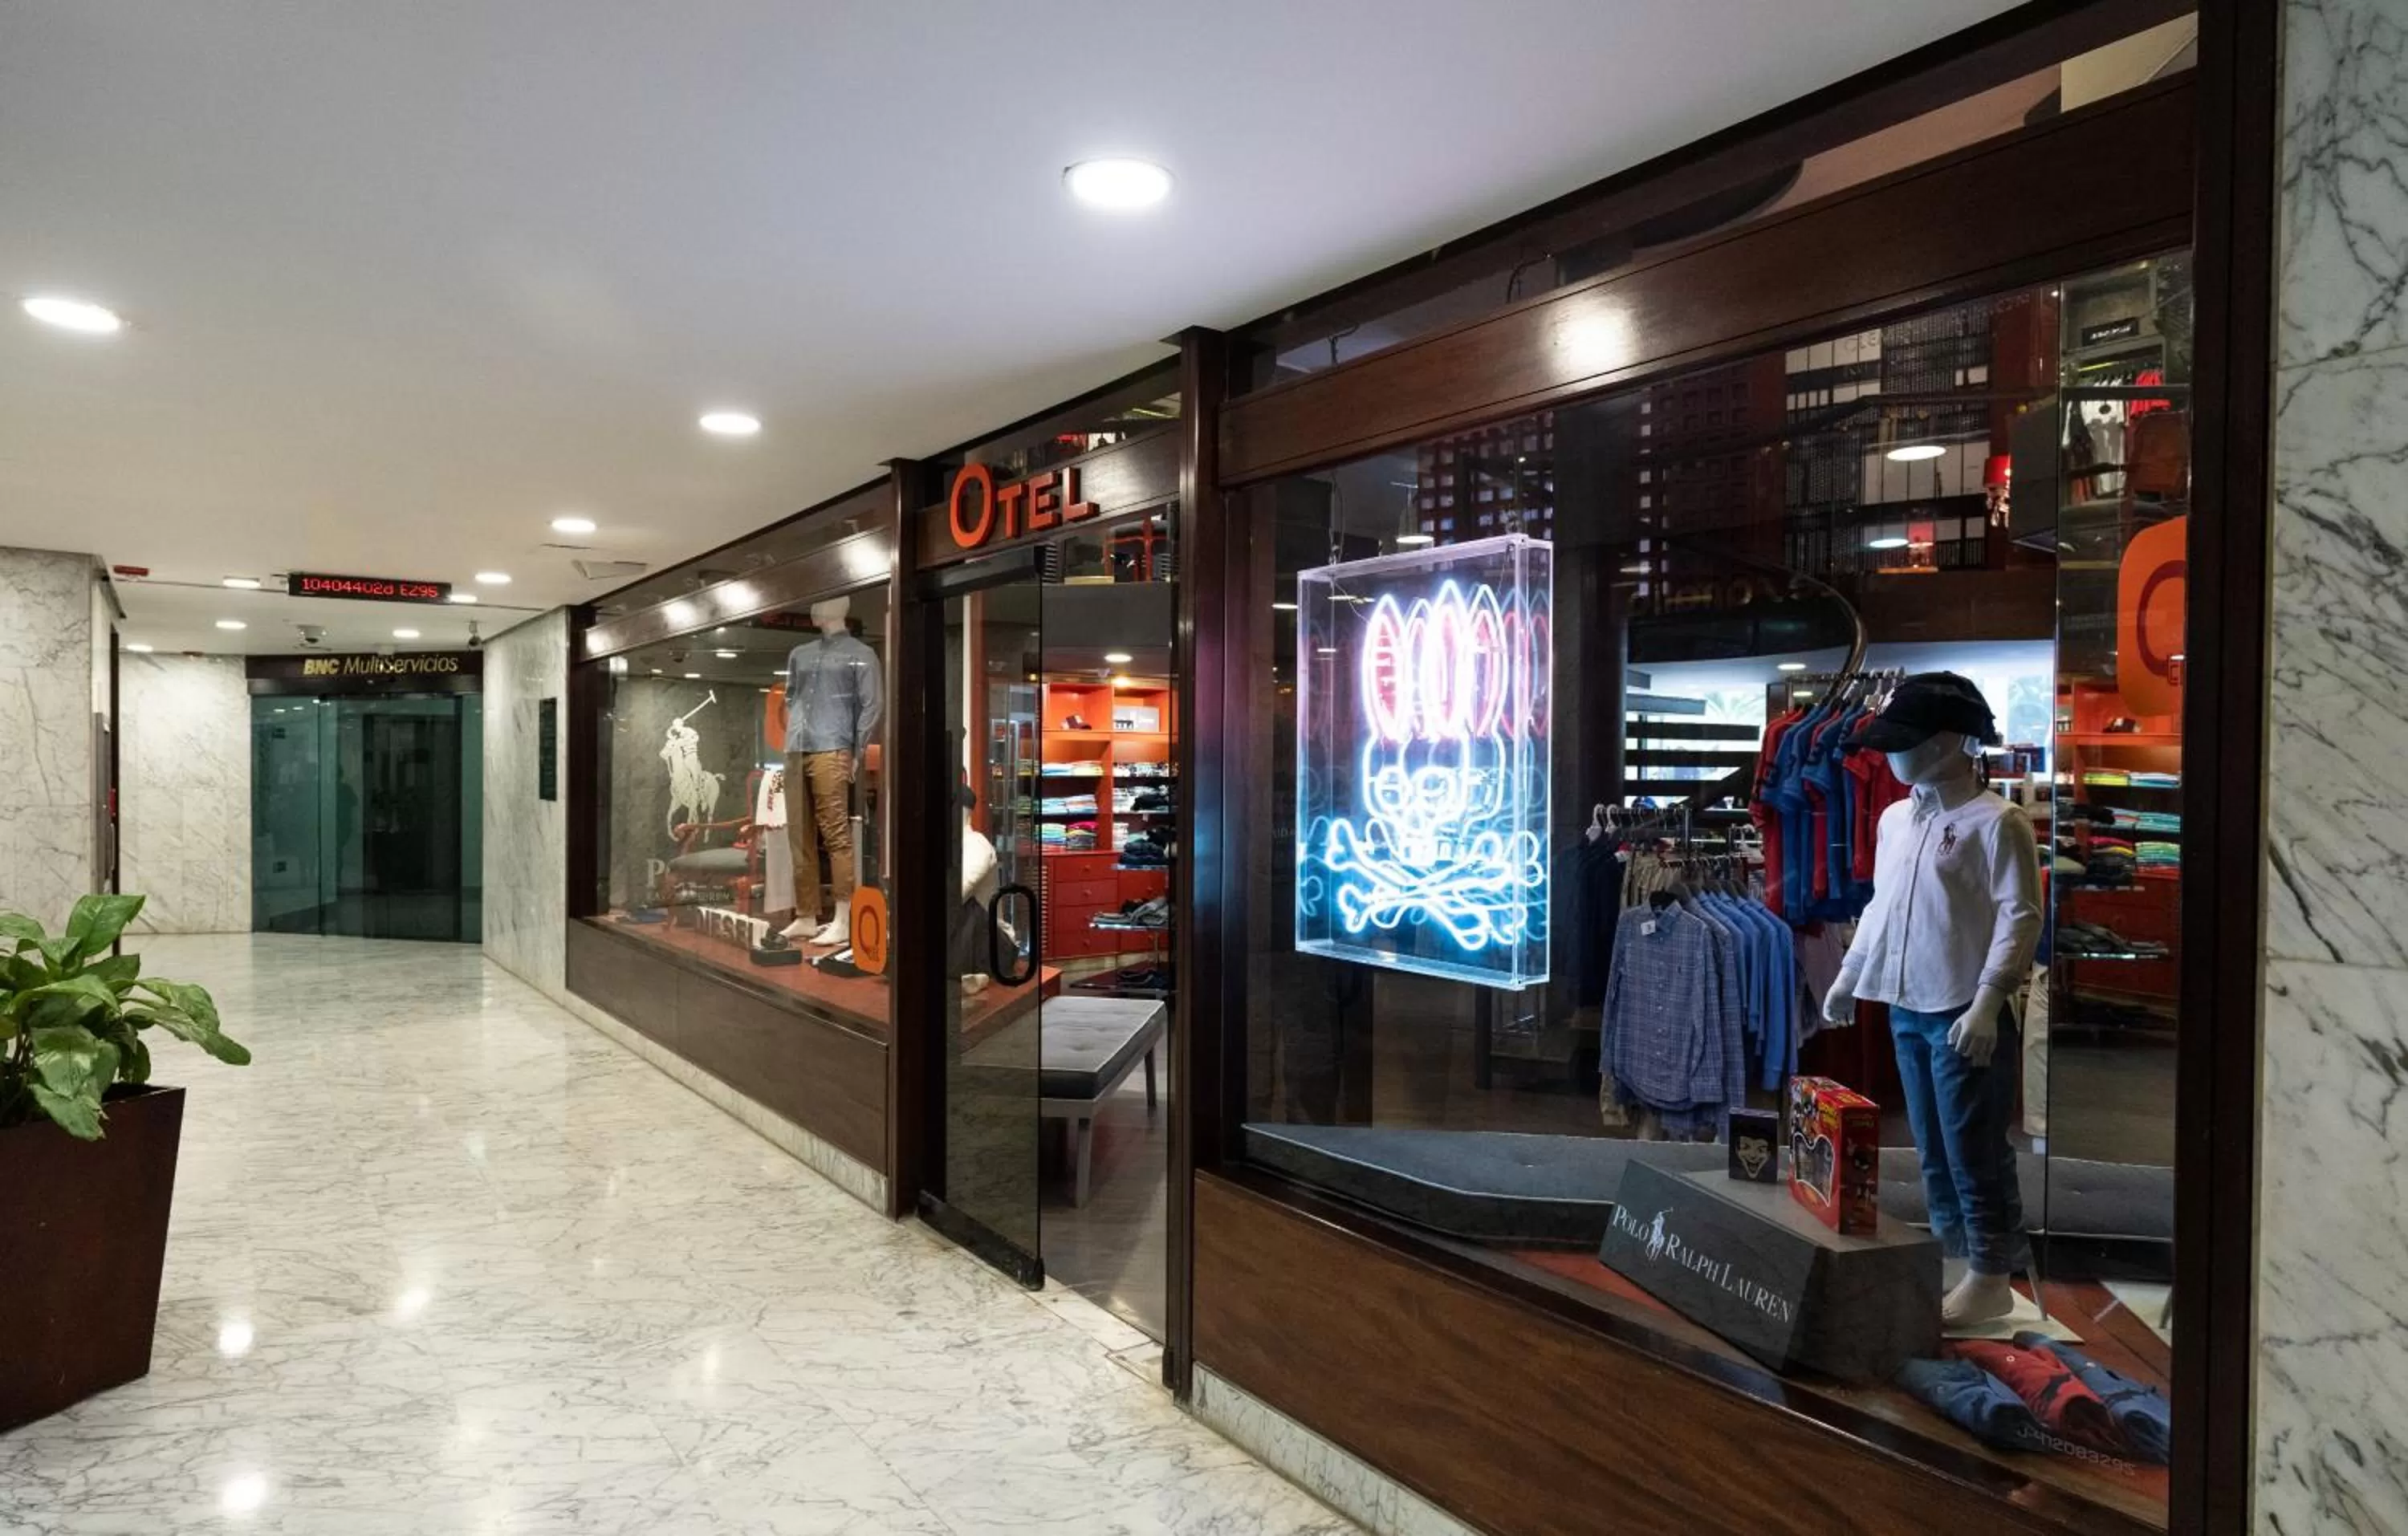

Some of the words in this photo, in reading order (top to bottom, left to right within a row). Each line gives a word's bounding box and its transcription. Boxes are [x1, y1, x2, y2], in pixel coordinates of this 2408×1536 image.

[303, 657, 340, 676] BNC
[344, 654, 459, 675] MultiServicios
[1613, 1204, 1649, 1242] POLO
[1665, 1233, 1721, 1282] RALPH
[1720, 1262, 1792, 1323] LAUREN
